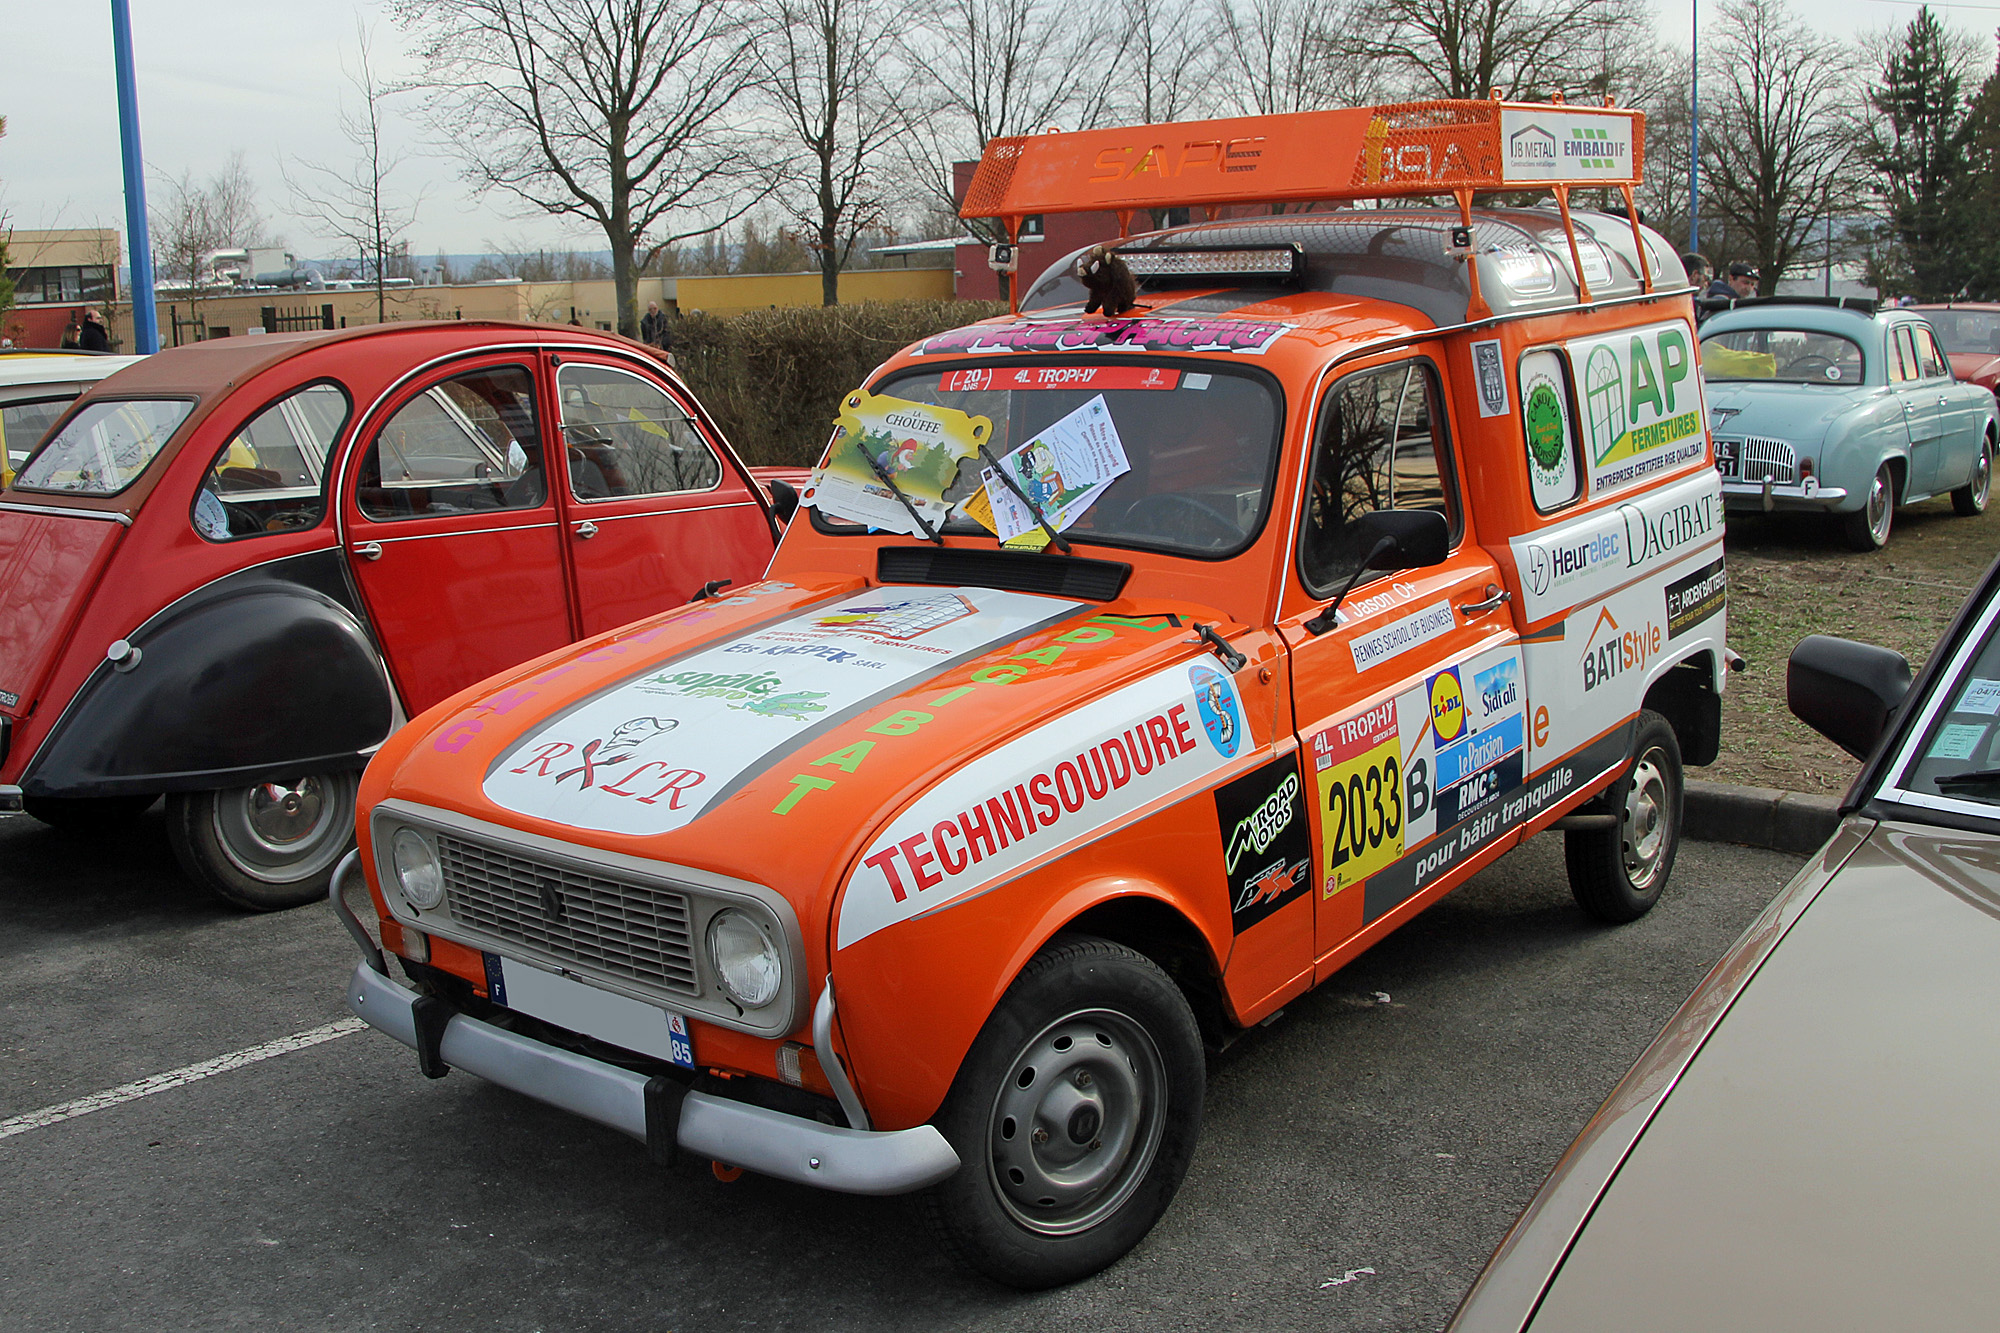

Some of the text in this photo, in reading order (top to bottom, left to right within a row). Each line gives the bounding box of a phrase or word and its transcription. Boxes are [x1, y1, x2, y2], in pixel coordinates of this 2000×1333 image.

[1514, 142, 1553, 158] JB METAL
[1564, 141, 1625, 156] EMBALDIF
[961, 383, 978, 391] ANS
[965, 369, 982, 382] 20
[1014, 369, 1098, 383] 4L TROPHY
[1629, 330, 1688, 425] AP
[886, 414, 941, 434] CHOUFFE
[1631, 415, 1697, 452] FERMETURES
[1596, 442, 1703, 491] ENTREPRISE CERTIFIEE RGE QUALIBAT
[1719, 461, 1734, 476] 51
[1805, 481, 1814, 495] F
[1615, 493, 1713, 569] DAGIBAT
[1553, 533, 1619, 579] Heurelec
[1349, 591, 1396, 618] Jason
[853, 633, 953, 655] FOURNITURES
[1354, 606, 1453, 664] RENNES SCHOOL OF BUSINESS
[852, 658, 888, 669] SARL
[1482, 690, 1503, 717] Sidi
[1314, 700, 1394, 754] 4L TROPHY
[864, 703, 1197, 903] TECHNISOUDURE
[1459, 773, 1488, 810] RMC
[1329, 755, 1401, 870] 2033
[1415, 766, 1574, 886] pour bâtir tranquille
[495, 984, 500, 996] F
[671, 1039, 692, 1064] 85
